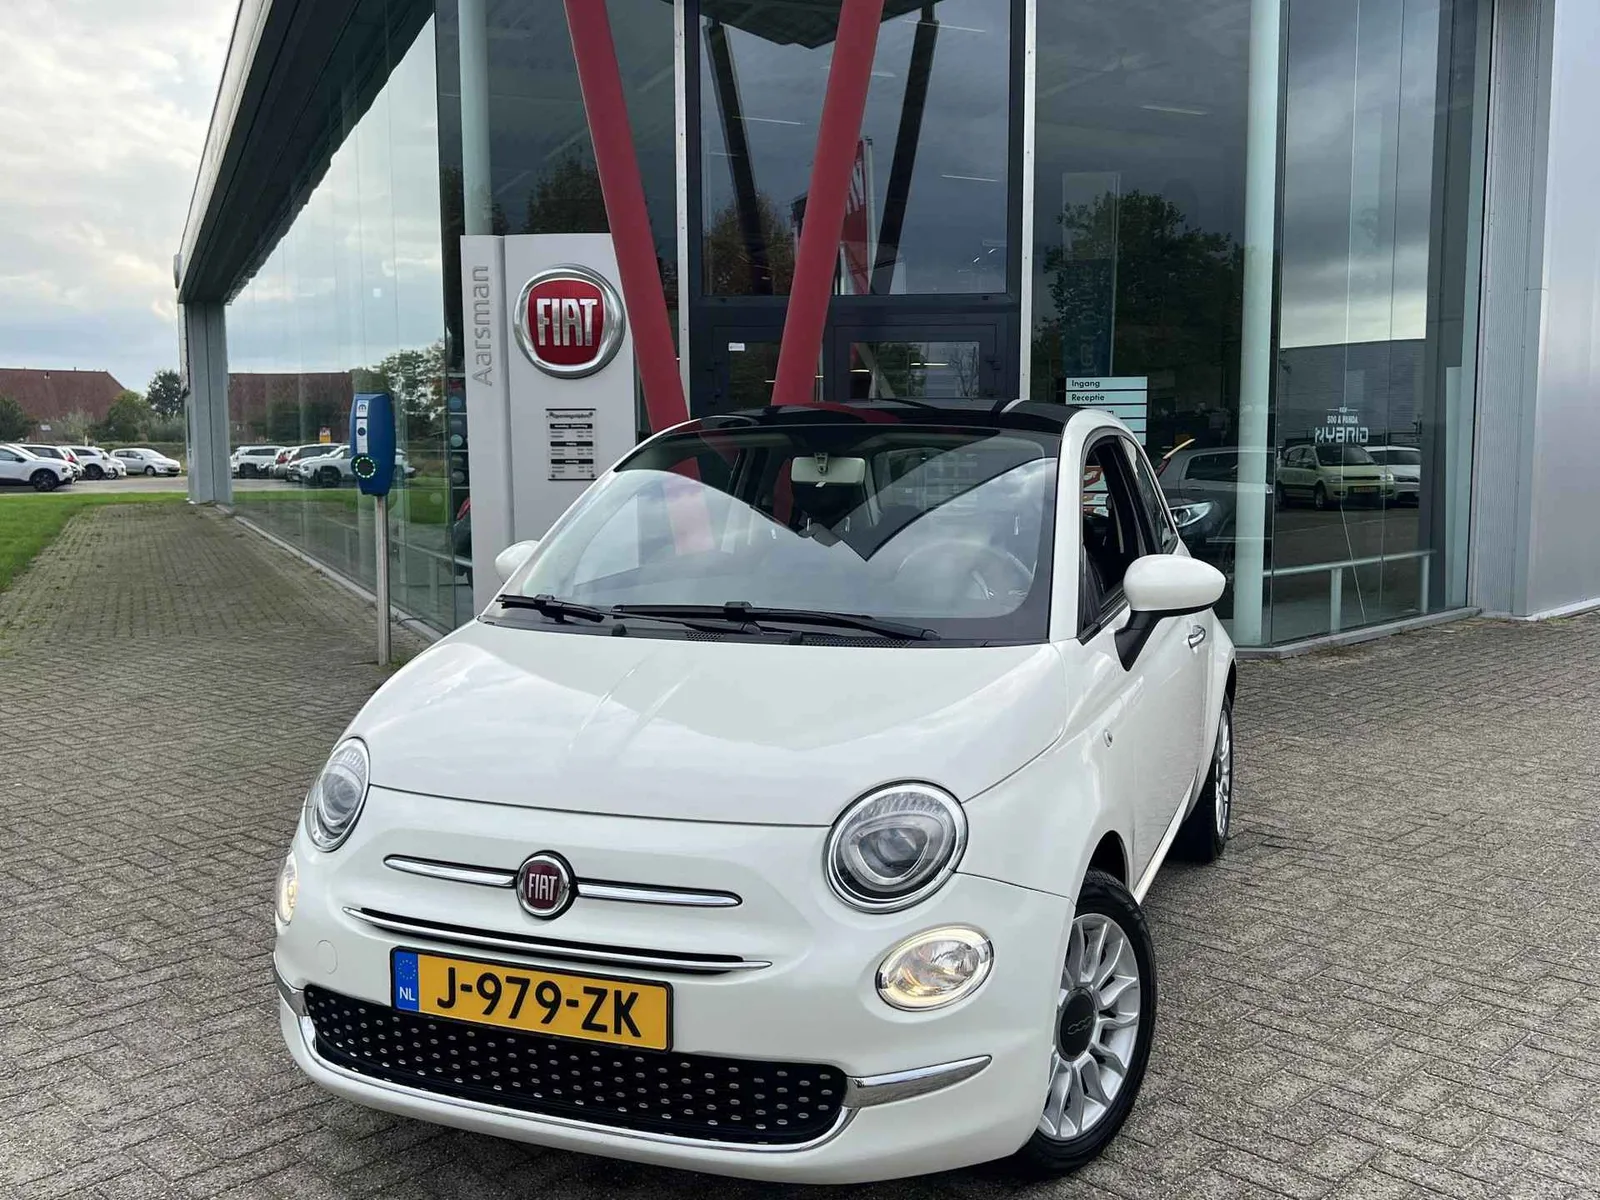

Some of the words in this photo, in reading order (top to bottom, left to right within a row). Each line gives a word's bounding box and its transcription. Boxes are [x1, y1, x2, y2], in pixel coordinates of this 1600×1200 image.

[472, 266, 492, 387] Aarsman
[536, 298, 598, 346] FIAT
[1071, 380, 1100, 388] Ingang
[1071, 393, 1105, 402] Receptie
[1314, 427, 1369, 443] HYBRID
[528, 872, 558, 901] FIAT
[399, 986, 416, 1002] NL
[436, 966, 642, 1038] J-979-ZK
